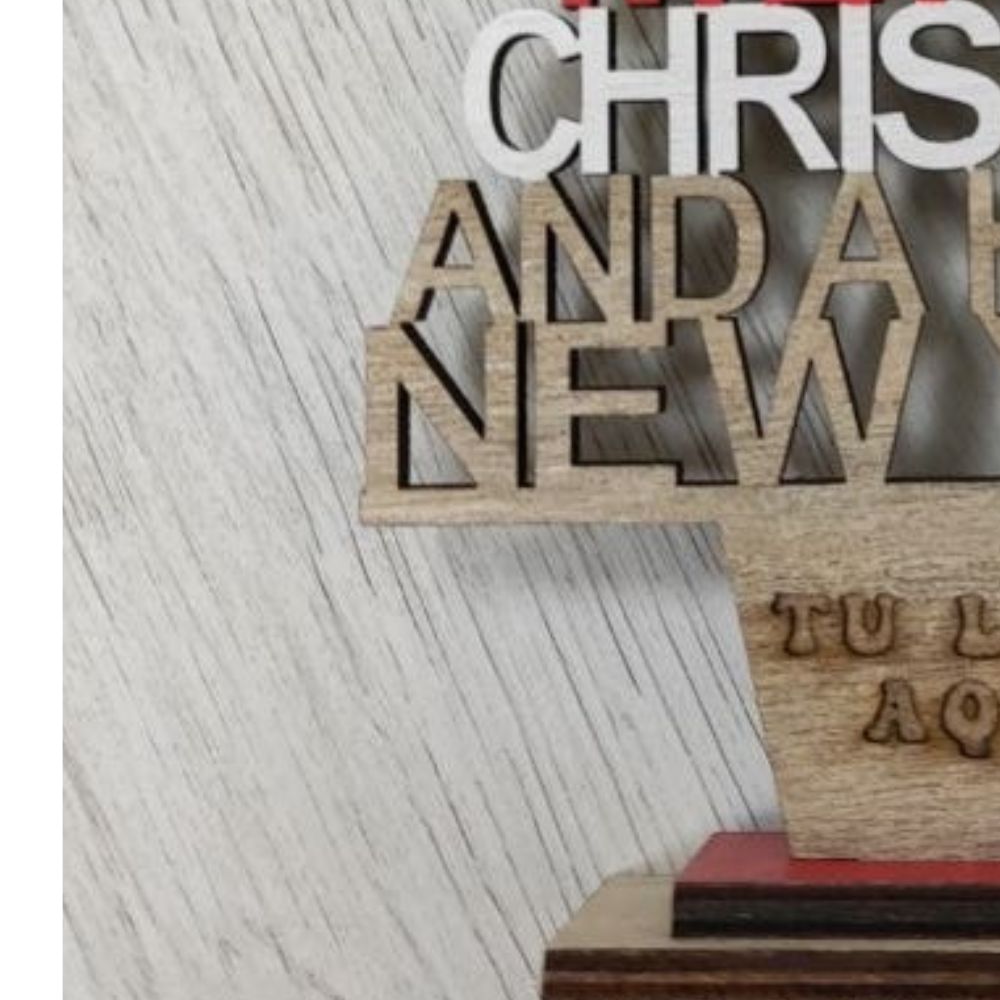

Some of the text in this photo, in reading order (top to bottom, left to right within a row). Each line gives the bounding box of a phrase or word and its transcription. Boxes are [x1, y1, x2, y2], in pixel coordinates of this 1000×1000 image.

[388, 170, 767, 325] AND
[803, 171, 928, 320] A
[363, 316, 926, 490] NEW
[769, 591, 899, 658] TU
